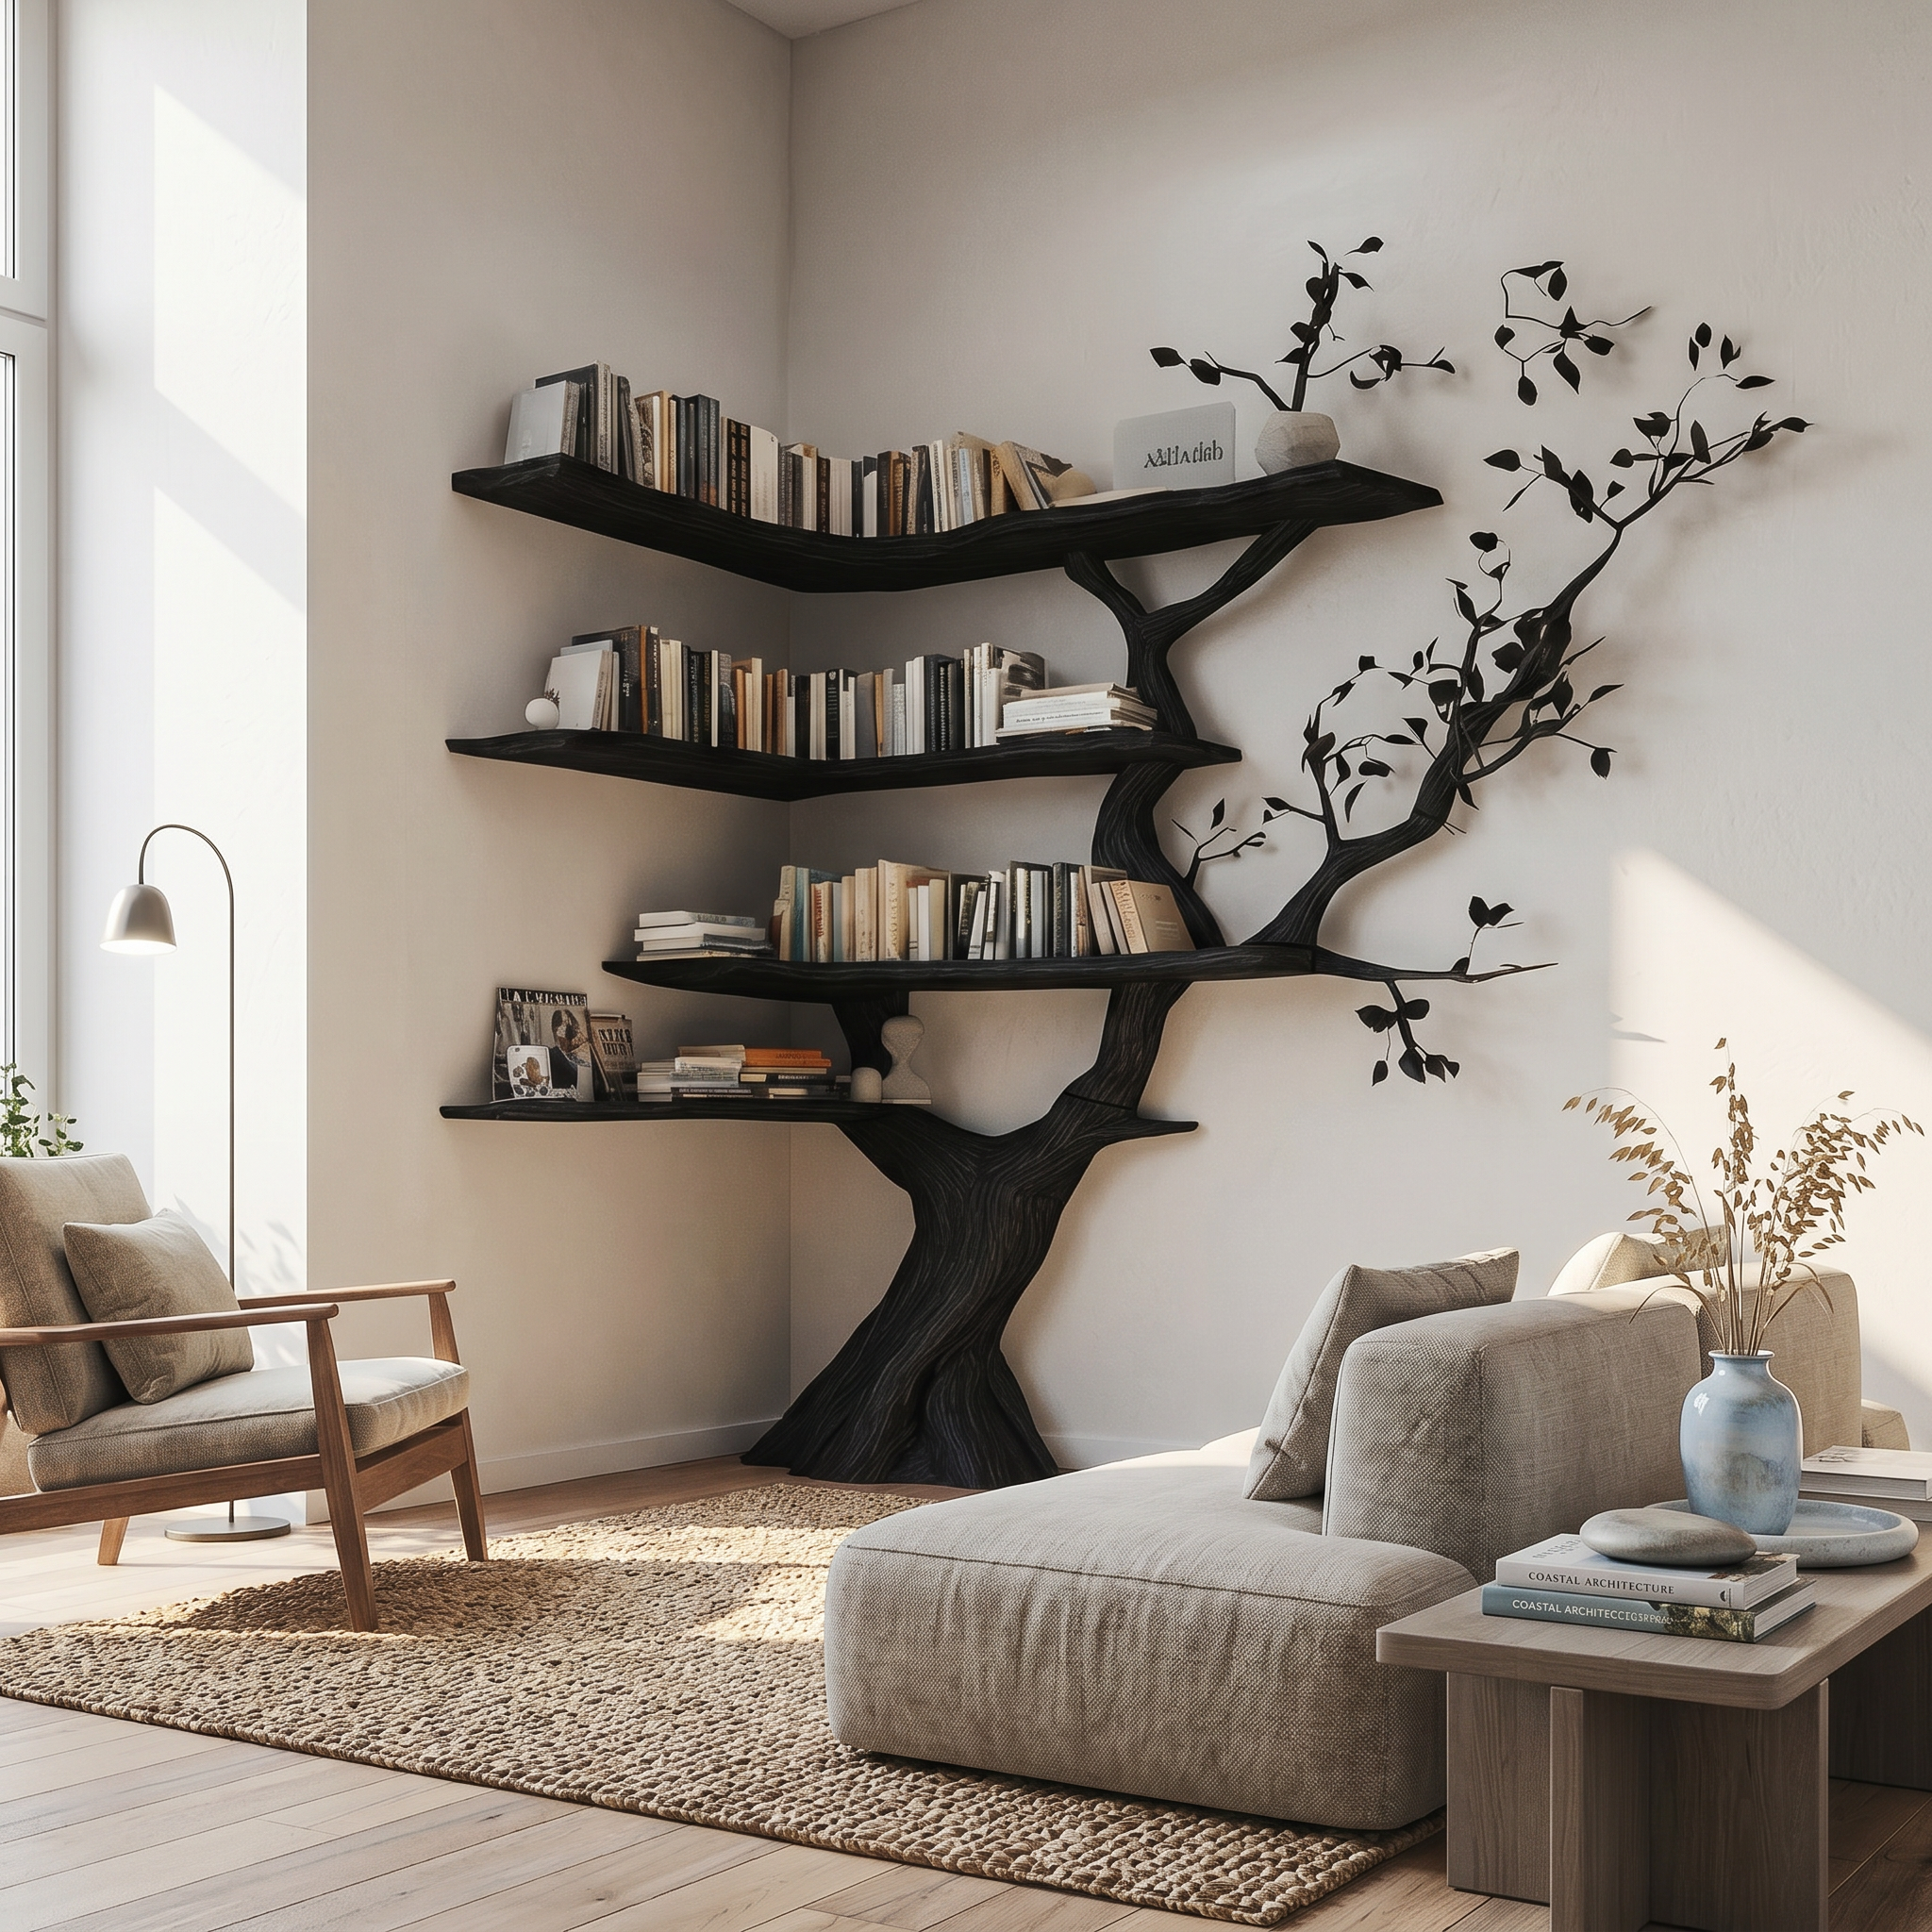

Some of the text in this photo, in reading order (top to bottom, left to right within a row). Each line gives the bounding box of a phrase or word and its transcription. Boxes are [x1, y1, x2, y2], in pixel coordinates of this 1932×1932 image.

[1528, 1572, 1674, 1594] COASTAL ARCHITECTURE
[1512, 1599, 1562, 1613] COASTAL
